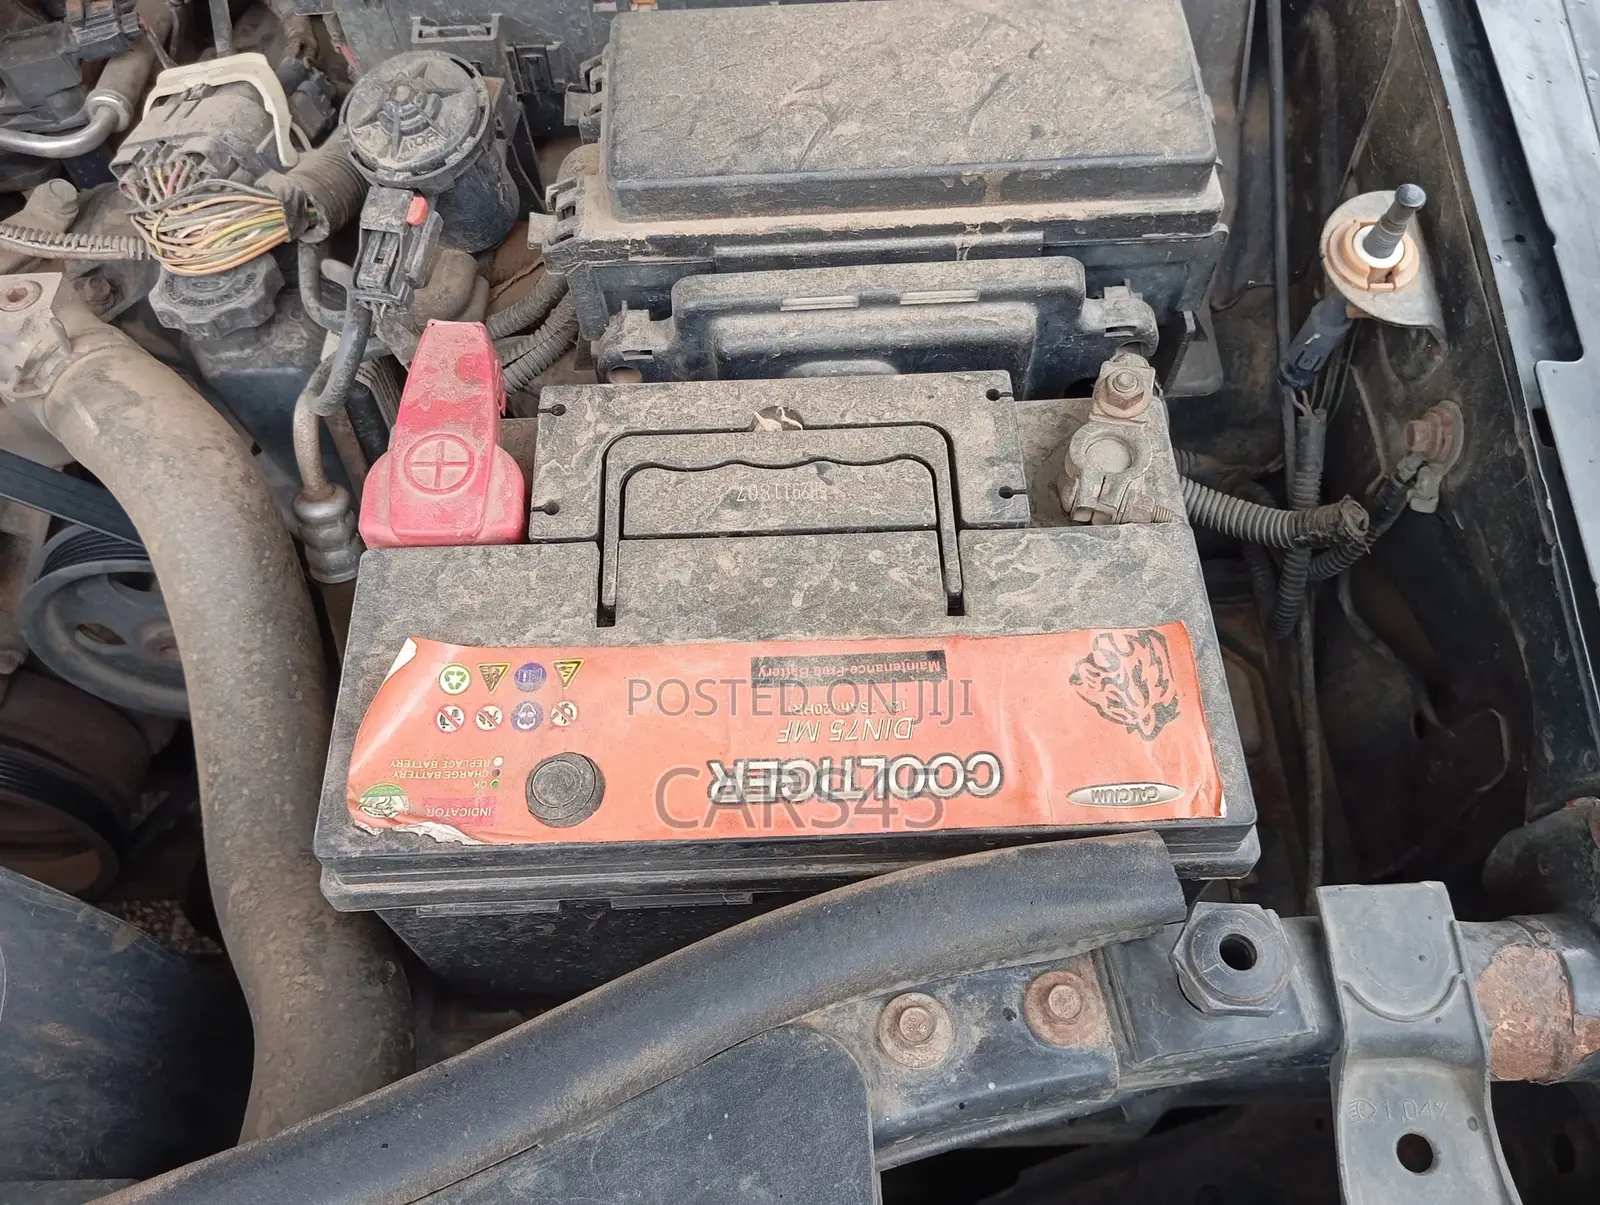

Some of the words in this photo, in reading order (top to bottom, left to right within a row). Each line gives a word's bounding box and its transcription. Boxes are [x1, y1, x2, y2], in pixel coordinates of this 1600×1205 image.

[758, 664, 808, 679] Battery
[776, 719, 822, 744] MF
[828, 717, 915, 742] DIN75
[389, 759, 439, 769] BATTERY
[441, 759, 491, 769] REPLACE
[392, 769, 442, 779] BATTERY
[444, 769, 489, 779] CHARGE
[706, 751, 1004, 807] COOLTIGER
[471, 779, 488, 789] OK
[1090, 785, 1161, 805] CALCIUM
[425, 806, 493, 818] INDICATOR
